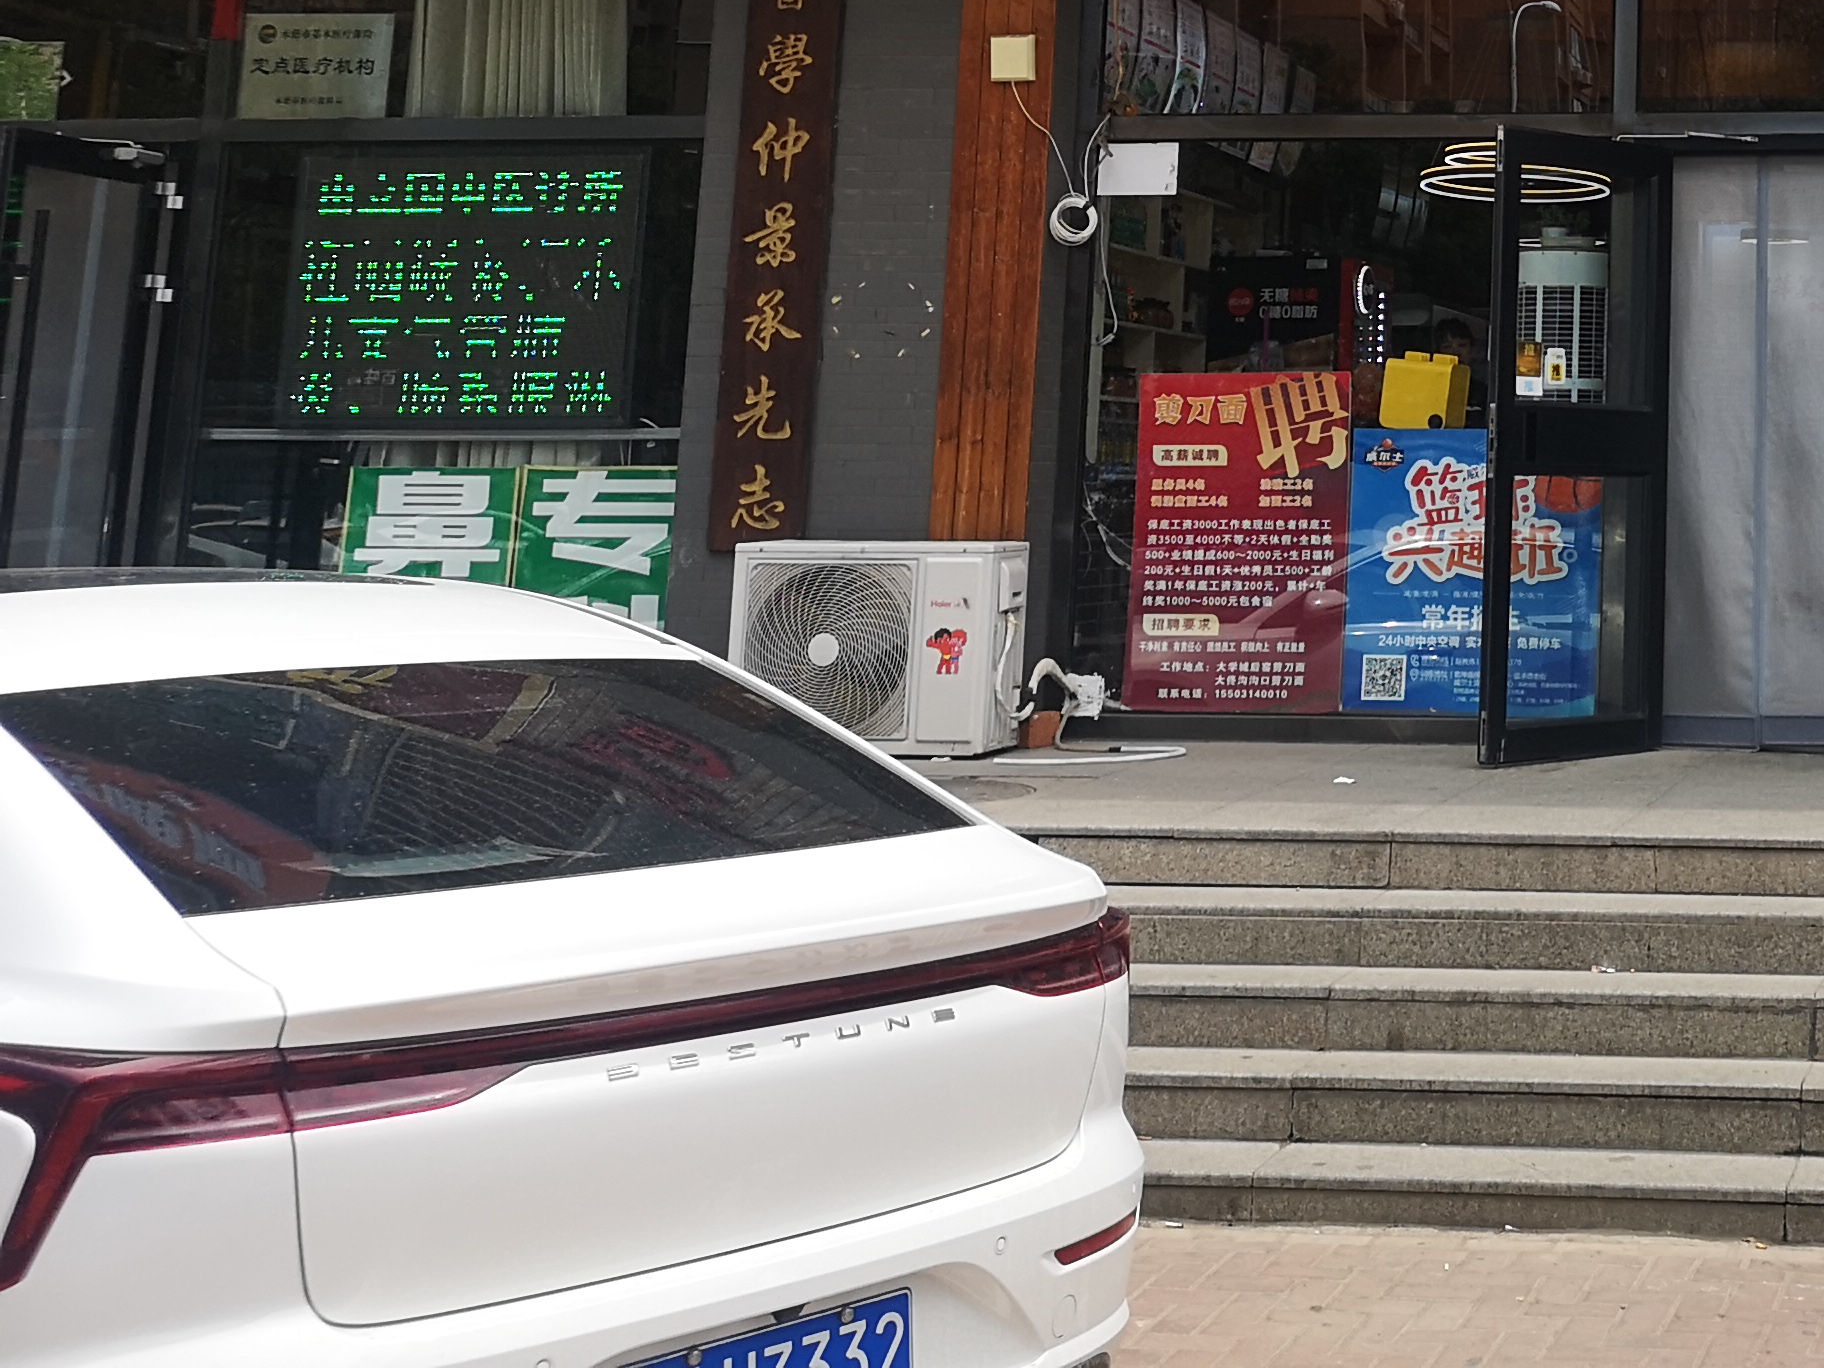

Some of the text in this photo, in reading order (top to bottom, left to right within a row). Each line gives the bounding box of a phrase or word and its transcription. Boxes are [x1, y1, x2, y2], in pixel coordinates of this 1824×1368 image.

[250, 56, 376, 76] 定点医疗机构
[1153, 393, 1248, 427] 剪刀面
[1250, 372, 1350, 479] 聘
[1160, 448, 1220, 462] 高薪诚聘
[353, 471, 500, 577] 鼻
[1150, 617, 1211, 632] 招聘要求
[1378, 635, 1461, 649] 24小时中央空调
[1516, 637, 1563, 651] 免费停车
[1214, 689, 1288, 699] 15503140010
[606, 1006, 956, 1082] BESTUNE
